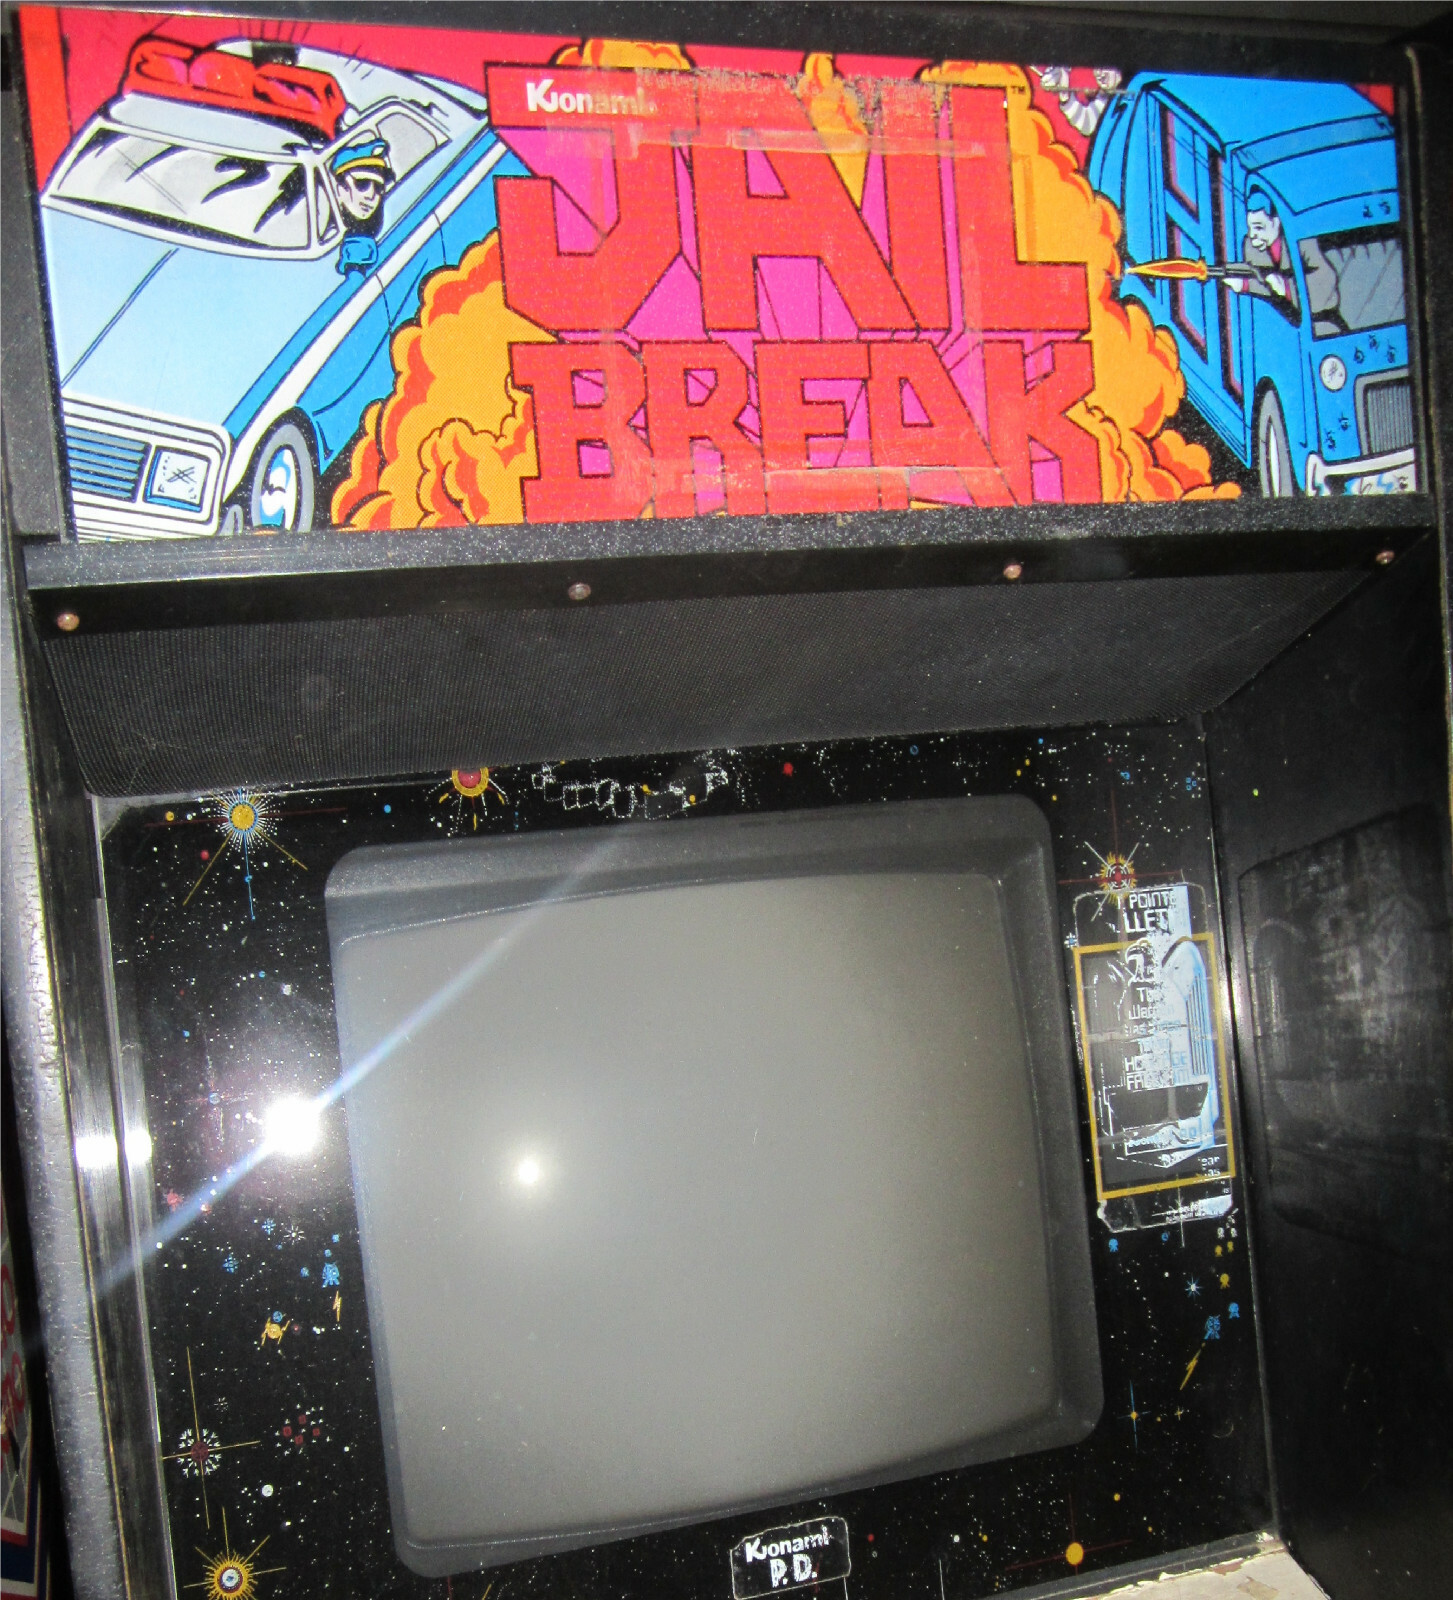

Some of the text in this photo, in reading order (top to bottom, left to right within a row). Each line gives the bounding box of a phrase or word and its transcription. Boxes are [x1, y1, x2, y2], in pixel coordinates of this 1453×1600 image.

[526, 79, 648, 115] Konami
[485, 62, 1091, 332] JAIL
[509, 340, 1104, 523] BREAK
[744, 1525, 830, 1563] Konami
